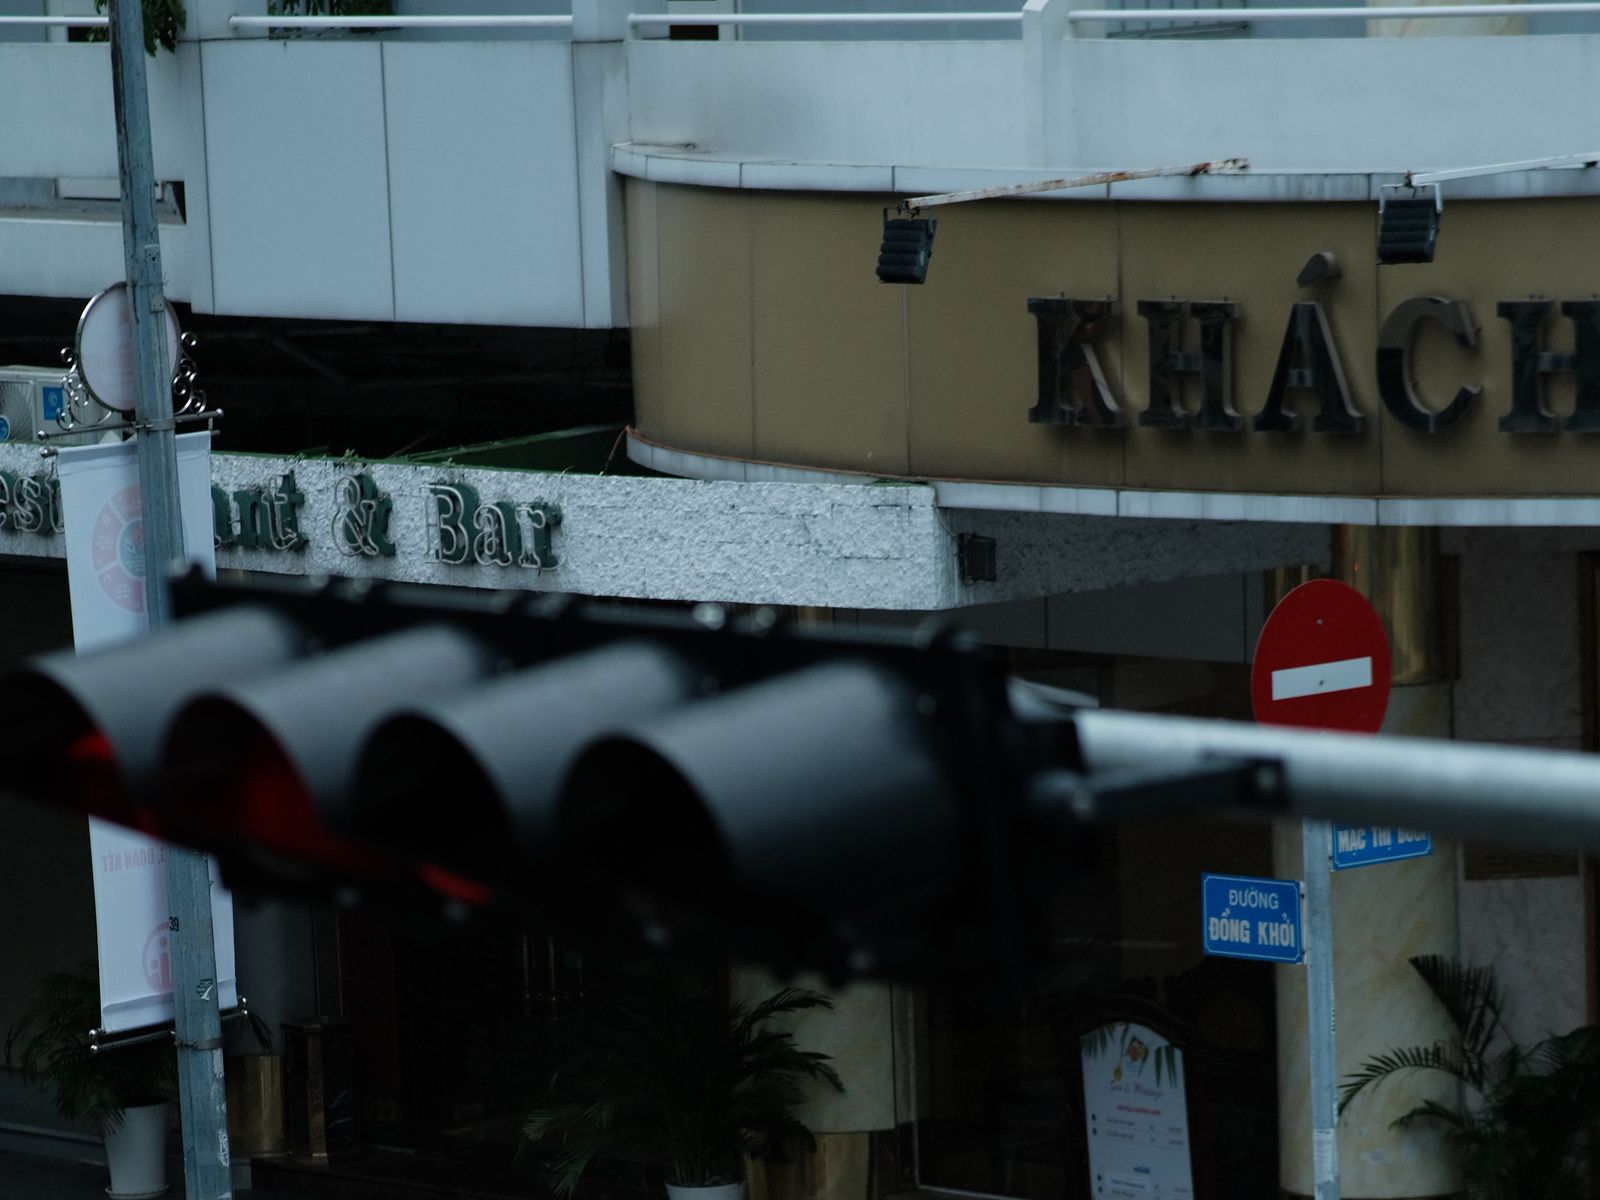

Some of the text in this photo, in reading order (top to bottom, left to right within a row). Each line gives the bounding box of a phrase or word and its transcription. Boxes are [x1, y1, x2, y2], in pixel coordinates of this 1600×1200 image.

[1027, 250, 1600, 433] KHÁCH
[331, 474, 396, 556] &
[420, 482, 569, 571] Bar
[1229, 887, 1279, 910] ĐƯỜNG
[168, 915, 179, 932] 39
[1209, 908, 1295, 947] ĐỒNG KHỞI
